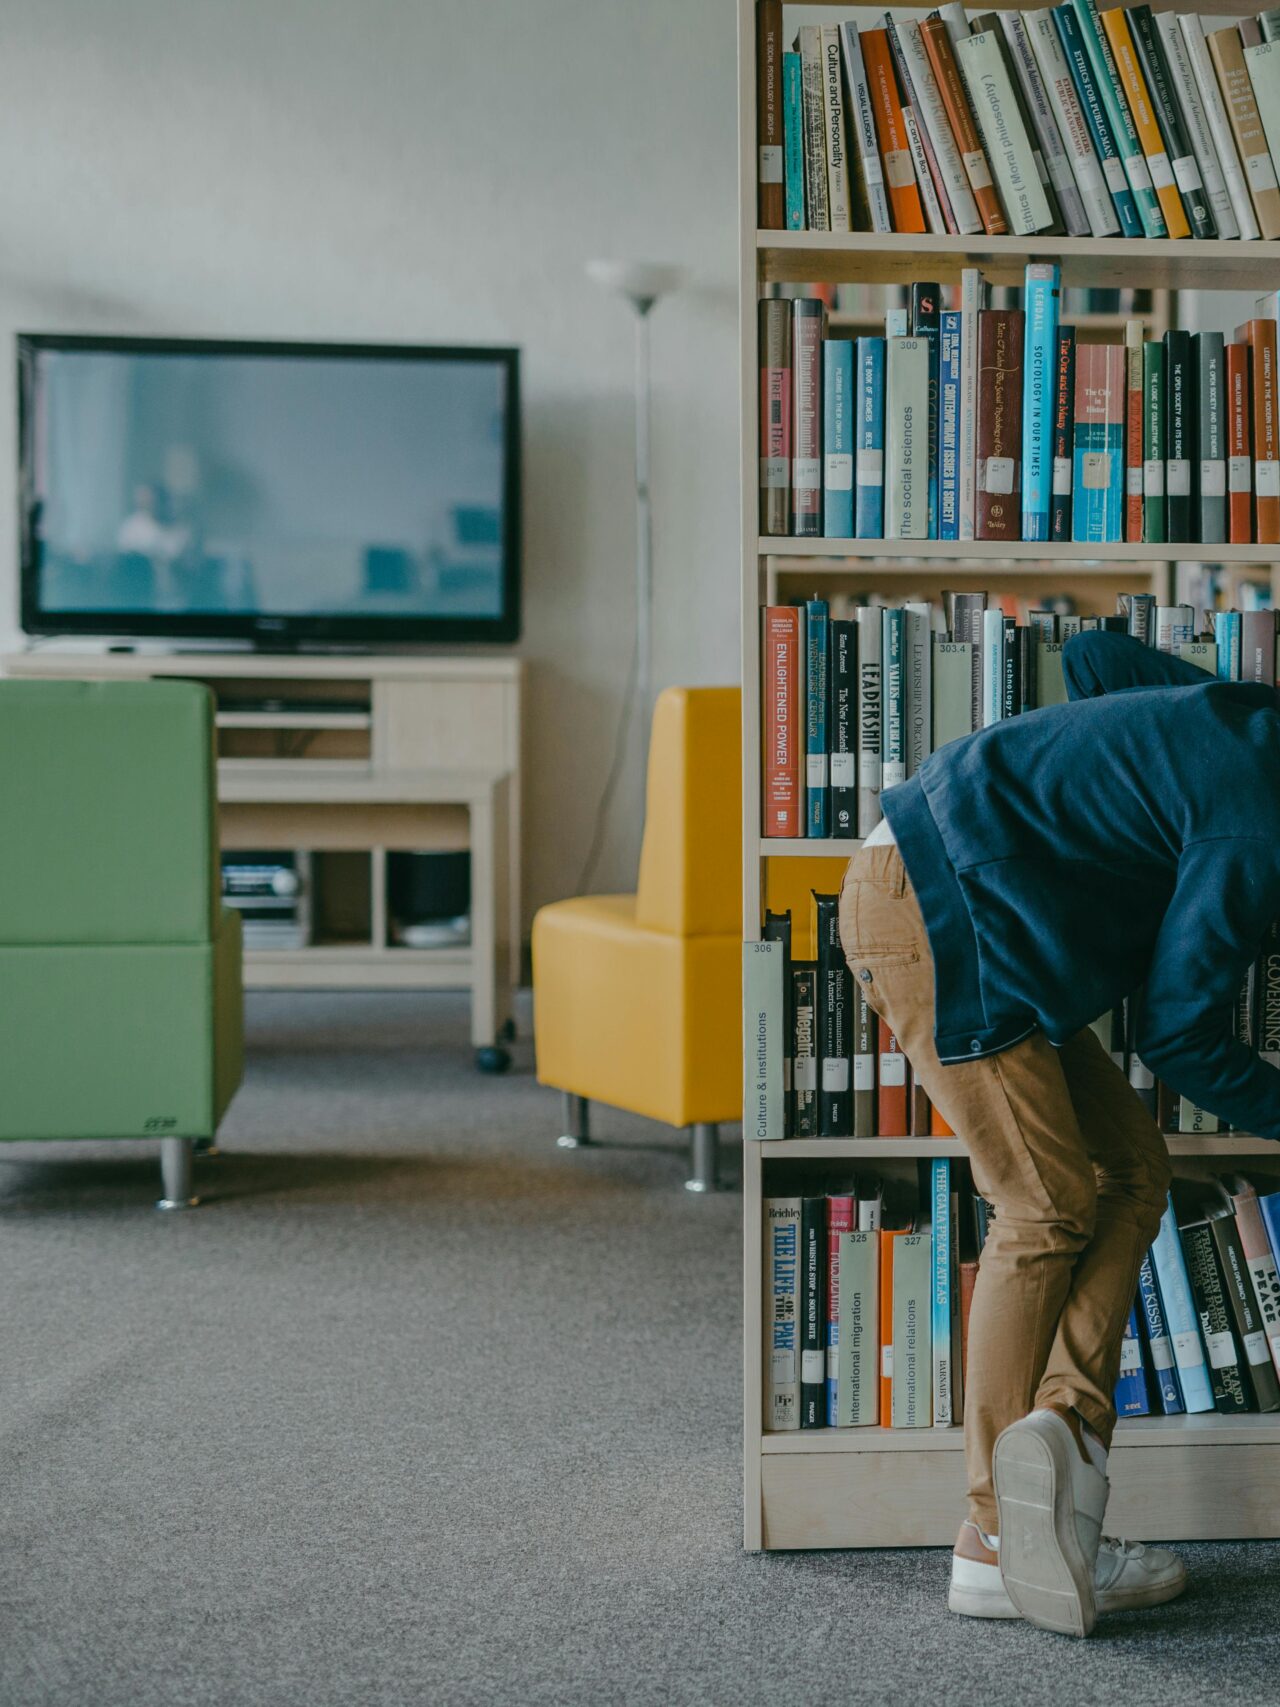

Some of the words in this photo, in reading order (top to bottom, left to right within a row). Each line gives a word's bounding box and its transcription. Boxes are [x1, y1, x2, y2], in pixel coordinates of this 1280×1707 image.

[1010, 18, 1023, 32] The
[968, 36, 986, 45] 170
[1013, 34, 1035, 68] Responsible
[1255, 45, 1271, 56] 200
[828, 45, 840, 83] Culture
[1074, 51, 1092, 82] ETHICS
[1091, 11, 1105, 35] ETHICS
[1098, 36, 1117, 75] CHALLENGE
[1113, 85, 1128, 109] PUBLIC
[1121, 111, 1137, 139] SERVICE
[830, 86, 841, 105] and
[858, 83, 868, 108] VISUAL
[1026, 70, 1050, 116] Administrator
[1084, 84, 1098, 102] FOR
[862, 110, 874, 147] ILLUSIONS
[984, 83, 1011, 150] philosophy
[1090, 104, 1107, 134] PUBLIC
[828, 109, 844, 168] Personality
[1004, 153, 1022, 186] Moral
[1018, 195, 1035, 231] Ethics
[1034, 288, 1045, 331] KENDALL
[901, 341, 917, 350] 300
[1061, 340, 1070, 354] The
[1033, 346, 1042, 402] SOCIOLOGY
[1061, 356, 1070, 373] One
[771, 371, 783, 398] FIRE
[1060, 376, 1069, 389] and
[1032, 408, 1042, 417] IN
[1060, 393, 1068, 404] the
[943, 384, 955, 447] CONTEMPORARY
[1057, 406, 1068, 429] Many
[903, 407, 913, 464] sciences
[1032, 423, 1041, 442] OUR
[943, 450, 955, 477] ISSUES
[1031, 446, 1041, 477] TIMES
[902, 469, 912, 507] social
[943, 480, 955, 488] IN
[943, 491, 955, 523] SOCIETY
[1054, 510, 1063, 532] Chicago
[900, 513, 912, 536] The
[940, 645, 965, 653] 303.4
[1192, 646, 1207, 654] 305
[777, 643, 787, 721] ENLIGHTENED
[914, 644, 923, 701] LEADERSHIP
[839, 689, 848, 702] The
[863, 664, 880, 754] LEADERSHIP
[914, 705, 923, 713] IN
[839, 704, 848, 719] New
[777, 725, 787, 765] POWER
[836, 970, 844, 999] Political
[758, 1012, 767, 1079] institutions
[757, 1095, 767, 1137] Culture
[937, 1167, 947, 1190] THE
[937, 1194, 947, 1223] GAIA
[774, 1224, 795, 1256] THE
[851, 1234, 867, 1242] 325
[905, 1237, 920, 1245] 327
[937, 1226, 947, 1264] PEACE
[774, 1260, 795, 1295] LIFE
[937, 1266, 947, 1304] ATLAS
[776, 1296, 784, 1320] THE
[786, 1301, 793, 1314] OF
[1254, 1270, 1276, 1322] PEACE
[851, 1293, 861, 1348] migration
[907, 1300, 916, 1350] relations
[851, 1351, 860, 1423] International
[906, 1354, 916, 1425] International
